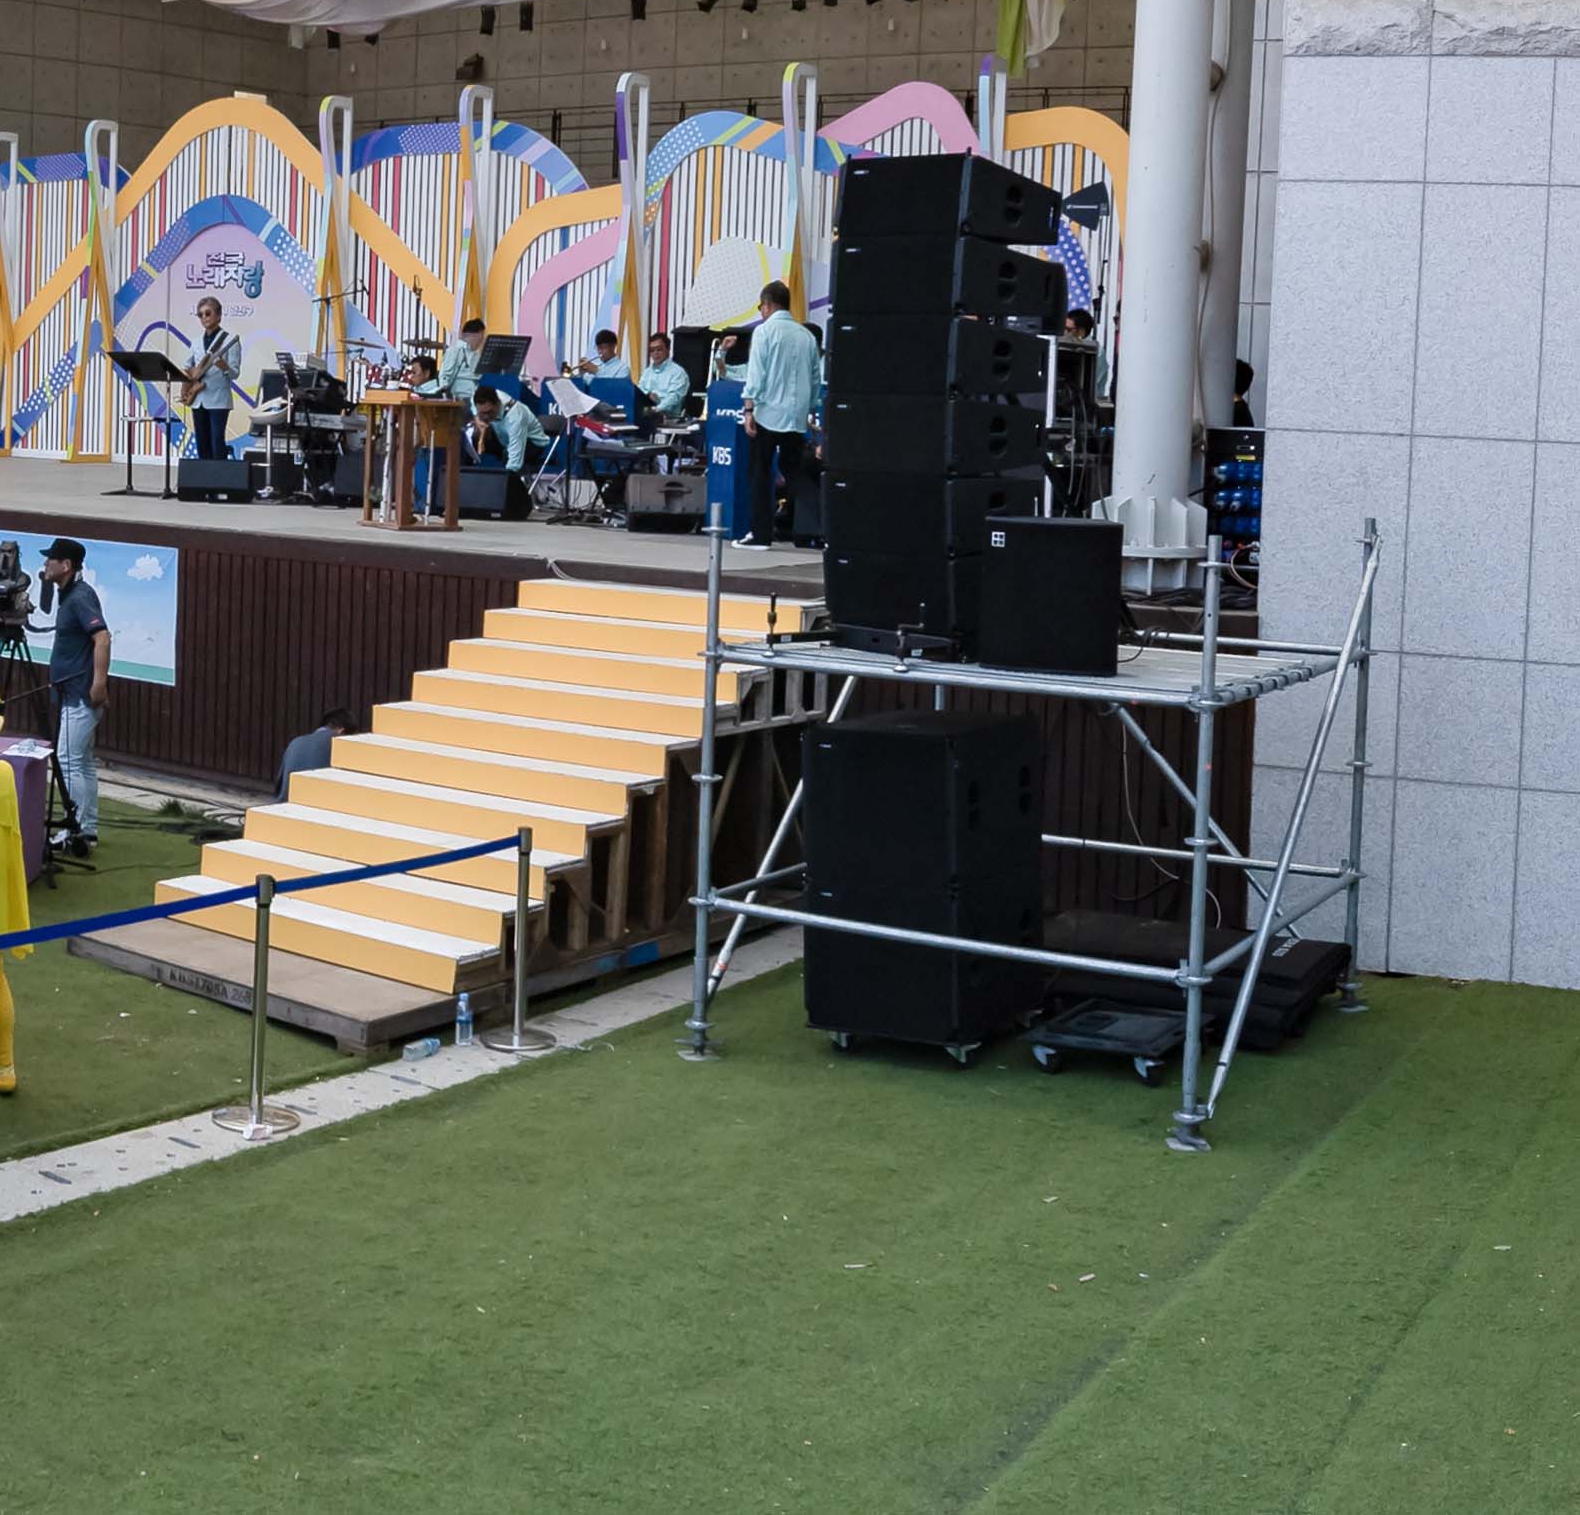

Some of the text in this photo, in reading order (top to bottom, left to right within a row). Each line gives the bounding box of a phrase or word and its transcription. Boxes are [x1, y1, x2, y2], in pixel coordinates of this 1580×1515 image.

[206, 251, 245, 267] 전국
[185, 260, 265, 299] 노래자랑
[712, 445, 732, 466] KBS
